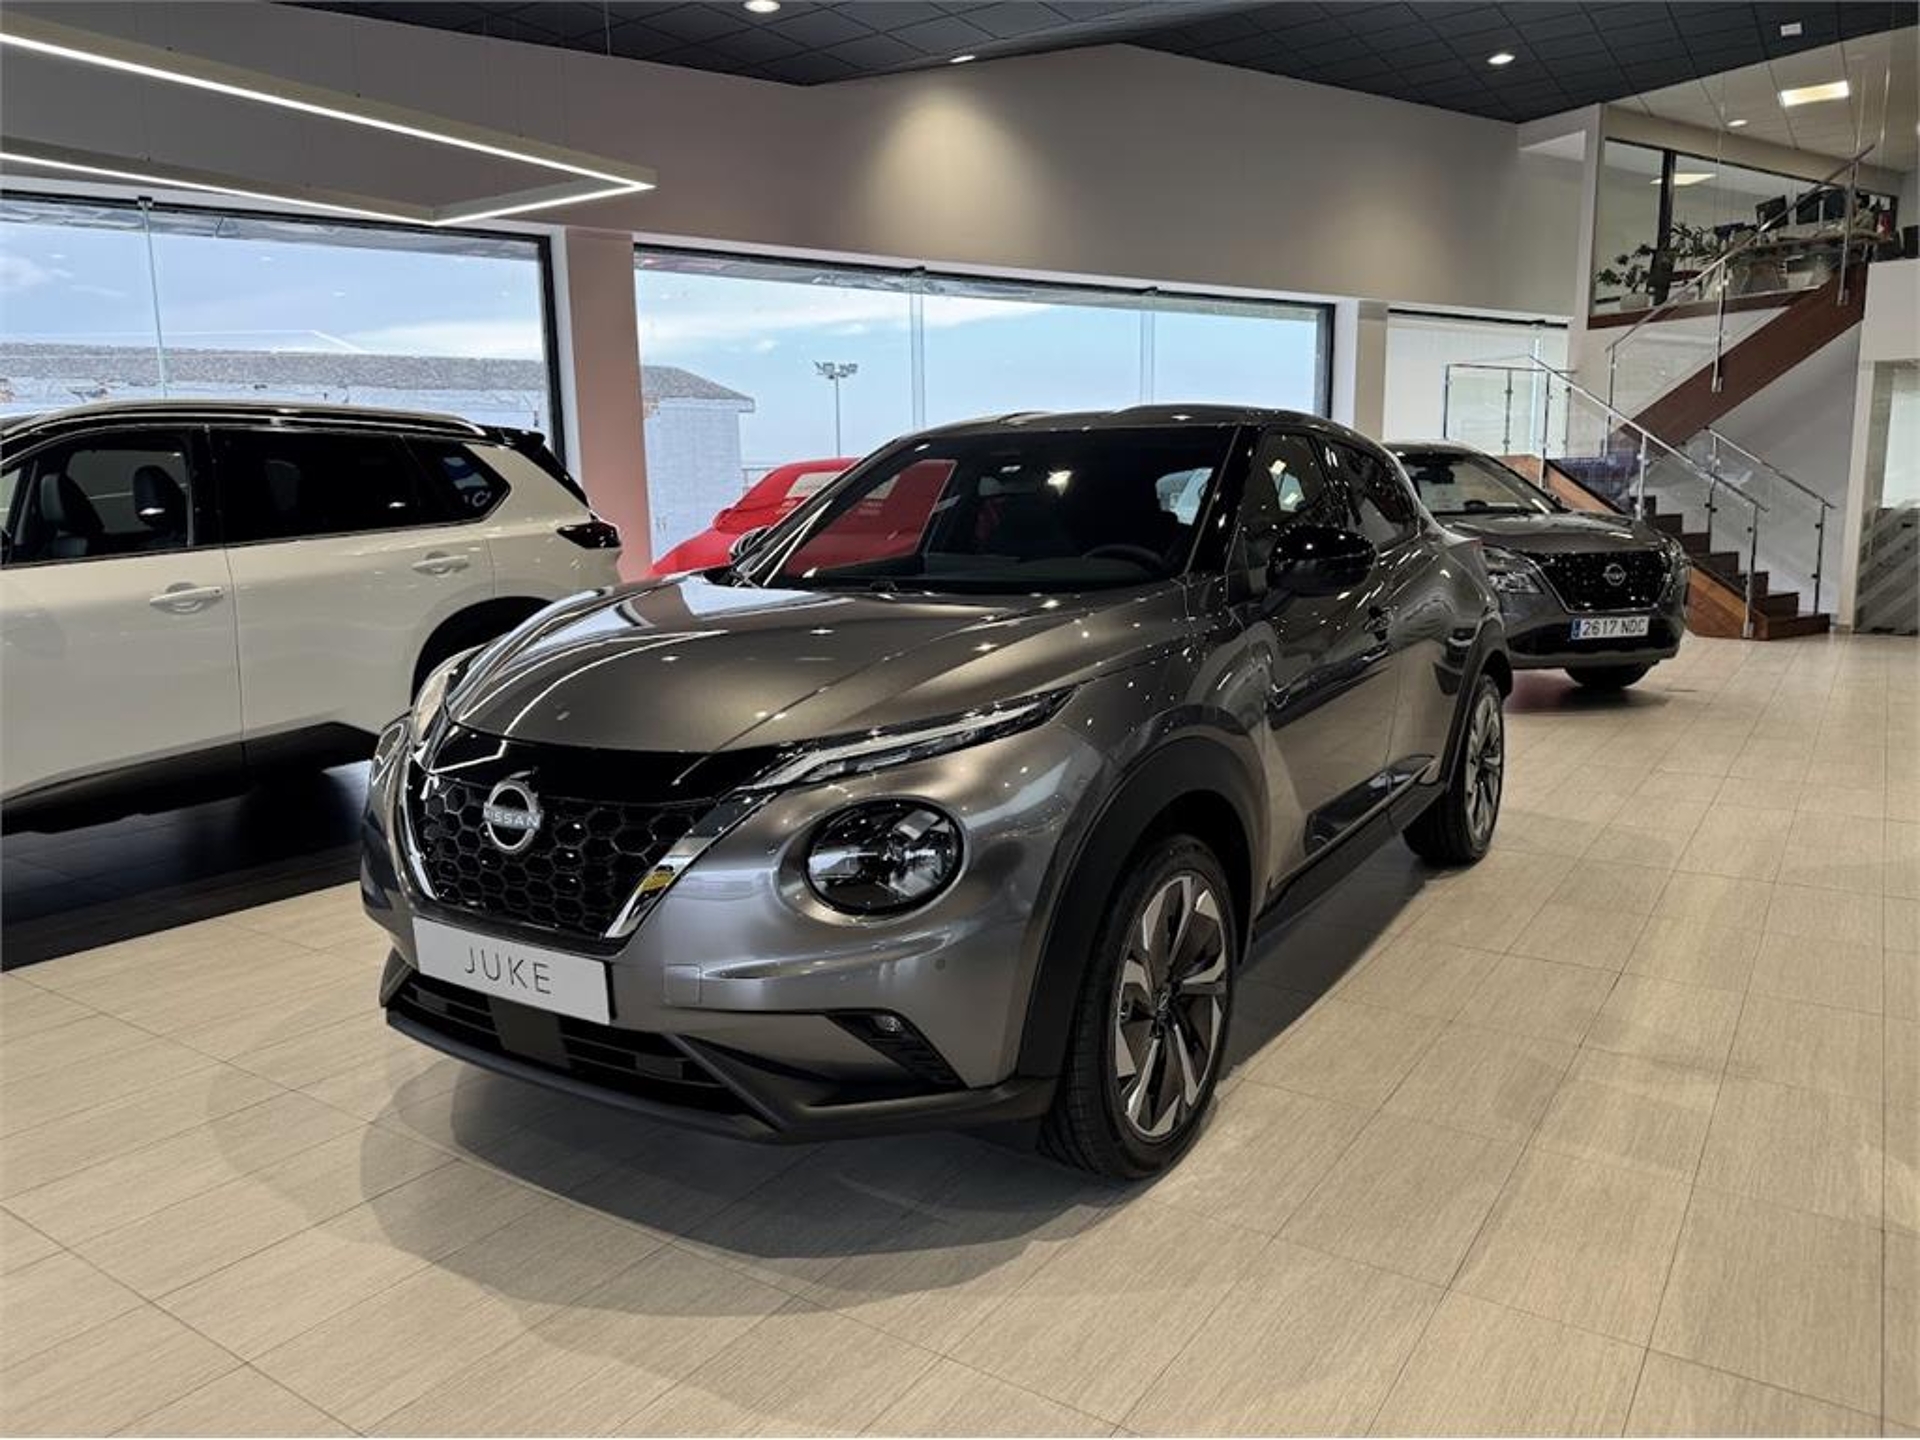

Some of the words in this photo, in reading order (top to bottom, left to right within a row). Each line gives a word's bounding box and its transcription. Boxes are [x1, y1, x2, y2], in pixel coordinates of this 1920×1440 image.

[1582, 620, 1618, 637] 2617
[1621, 618, 1645, 634] NDC
[465, 947, 551, 994] JUKE
